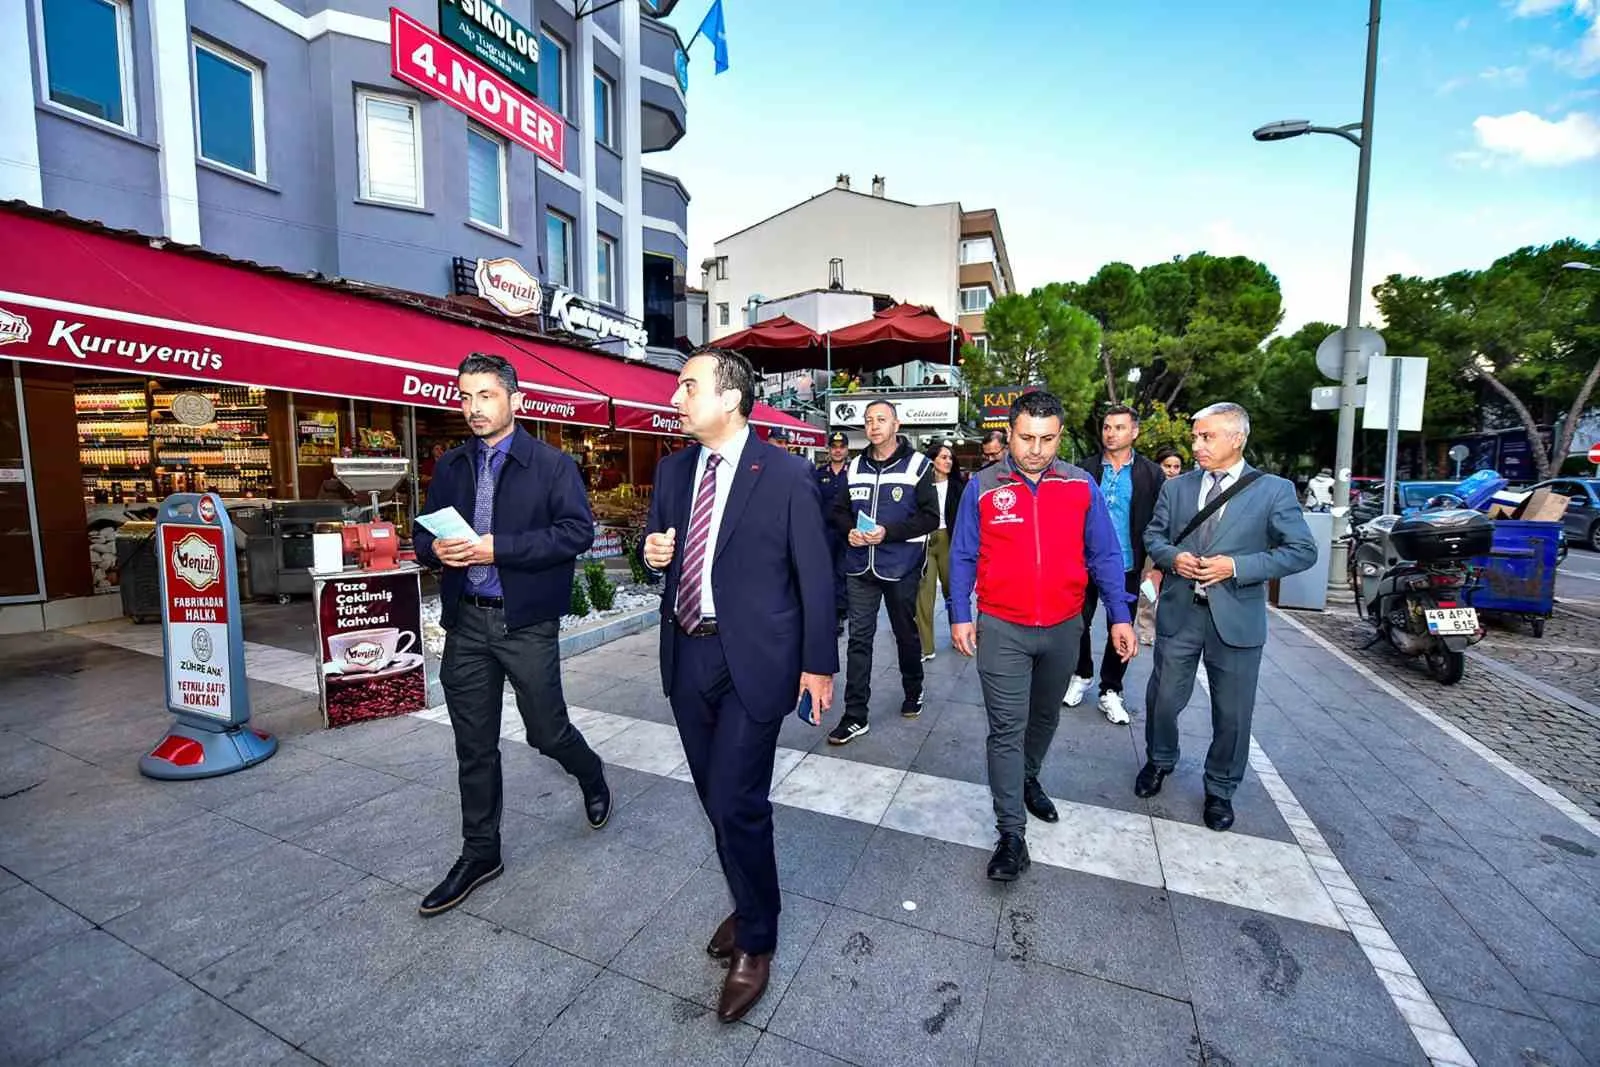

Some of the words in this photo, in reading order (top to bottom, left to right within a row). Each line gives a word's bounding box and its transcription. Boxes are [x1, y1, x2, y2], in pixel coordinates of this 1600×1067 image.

[335, 582, 367, 592] Taze
[336, 590, 393, 606] Çekilmiş
[185, 609, 216, 621] HALKA
[337, 604, 367, 616] Türk
[1429, 610, 1445, 620] 48
[1449, 609, 1472, 619] APV
[337, 612, 389, 628] Kahvesi
[1453, 620, 1476, 630] 615
[183, 693, 220, 707] NOKTASI
